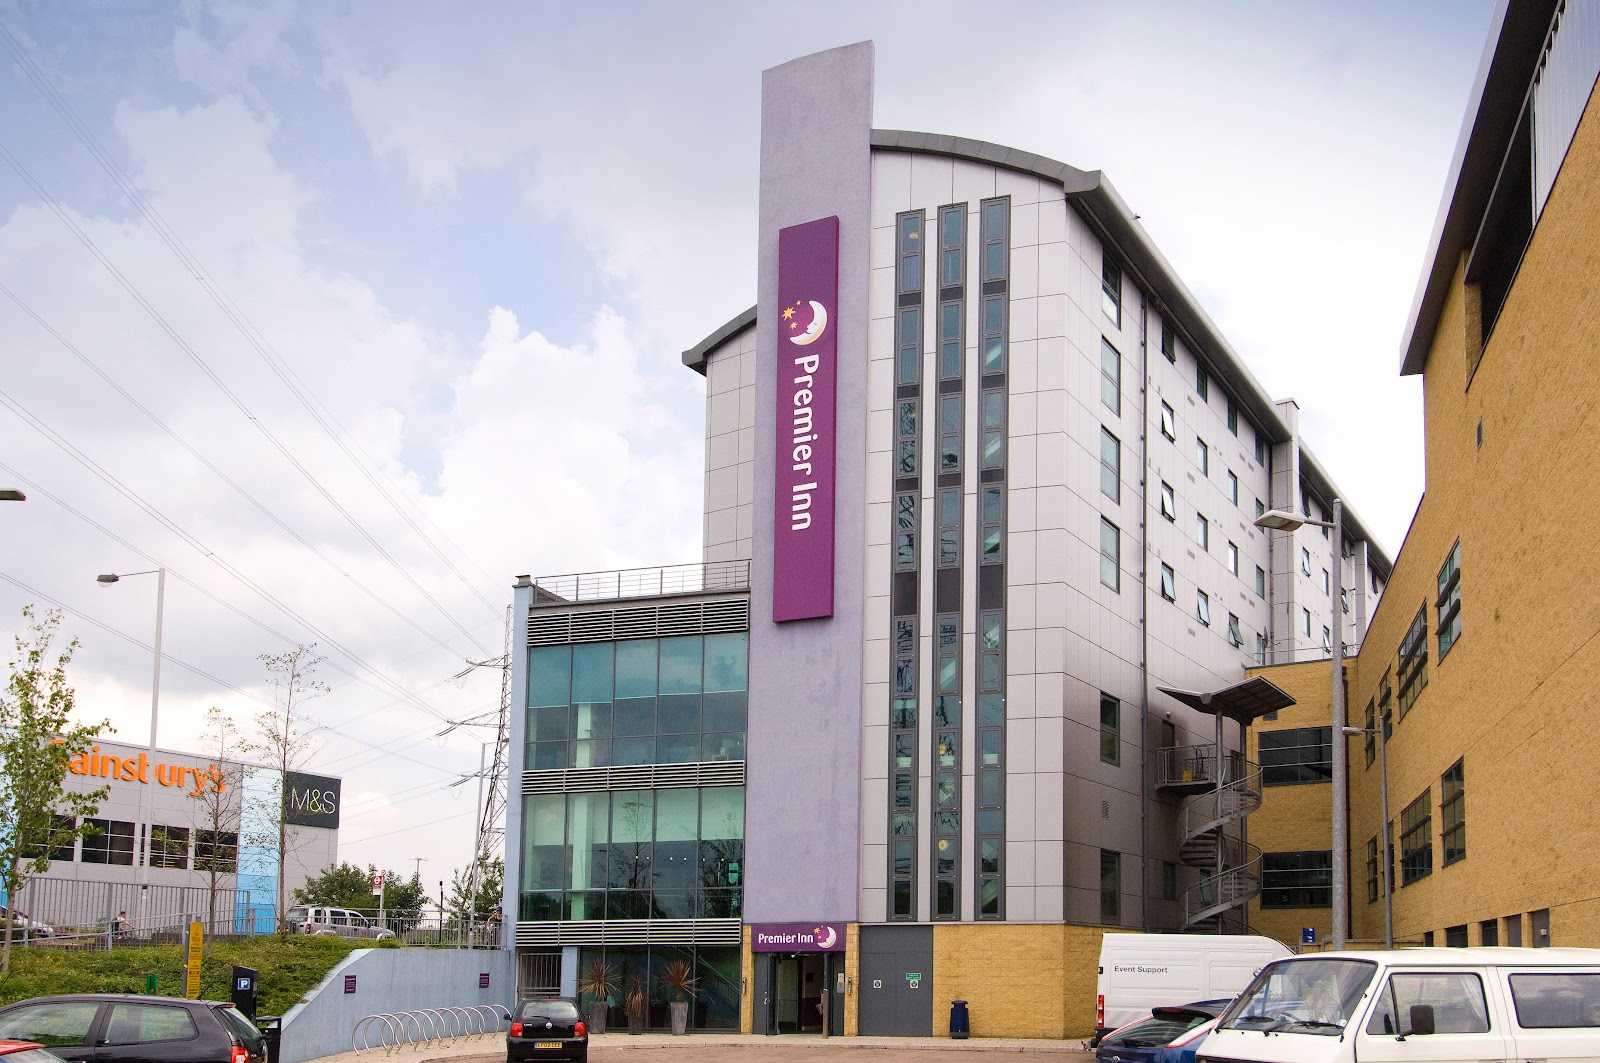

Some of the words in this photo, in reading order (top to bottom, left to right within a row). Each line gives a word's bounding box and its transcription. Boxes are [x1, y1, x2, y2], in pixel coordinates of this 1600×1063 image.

[793, 354, 819, 476] Premier
[791, 482, 818, 531] Inn
[50, 739, 227, 797] ainsbury's
[291, 788, 336, 814] M&S
[758, 932, 797, 944] Premier
[797, 932, 814, 943] Inn
[1137, 966, 1168, 974] Support
[240, 980, 249, 988] P
